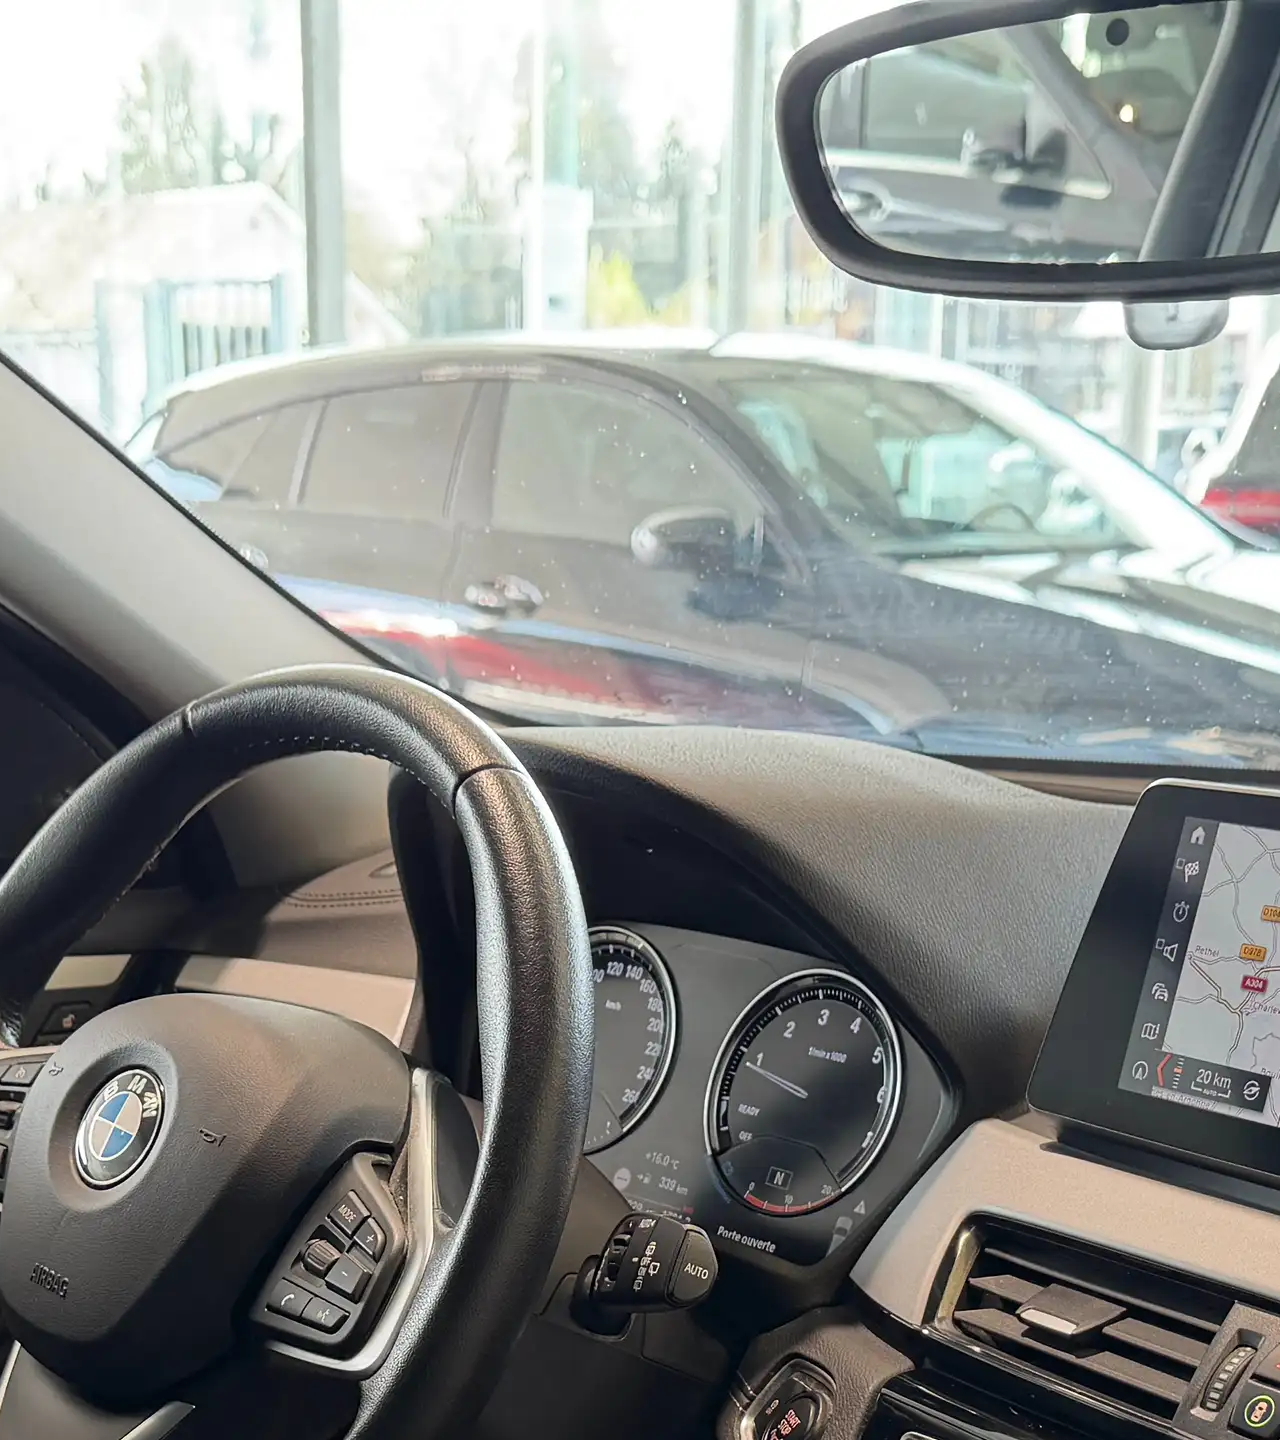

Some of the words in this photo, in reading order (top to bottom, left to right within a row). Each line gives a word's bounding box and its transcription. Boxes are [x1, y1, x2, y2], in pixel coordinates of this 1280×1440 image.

[607, 961, 624, 977] 120
[625, 964, 643, 981] 140
[639, 978, 657, 994] 160
[818, 1009, 830, 1026] 3
[850, 1016, 862, 1034] 4
[783, 1021, 796, 1039] 2
[756, 1052, 764, 1067] 1
[872, 1046, 883, 1064] 5
[1196, 1068, 1212, 1085] 20
[1213, 1071, 1232, 1089] km
[103, 1074, 160, 1118] BMW
[738, 1103, 760, 1117] READY
[738, 1130, 753, 1142] OFF
[658, 1176, 677, 1191] 339
[676, 1185, 689, 1196] km
[774, 1171, 785, 1186] N
[784, 1195, 794, 1204] 10
[717, 1225, 741, 1243] Porte
[740, 1235, 777, 1254] ouverte
[684, 1262, 709, 1280] AUTO
[30, 1262, 69, 1300] AIRBAG
